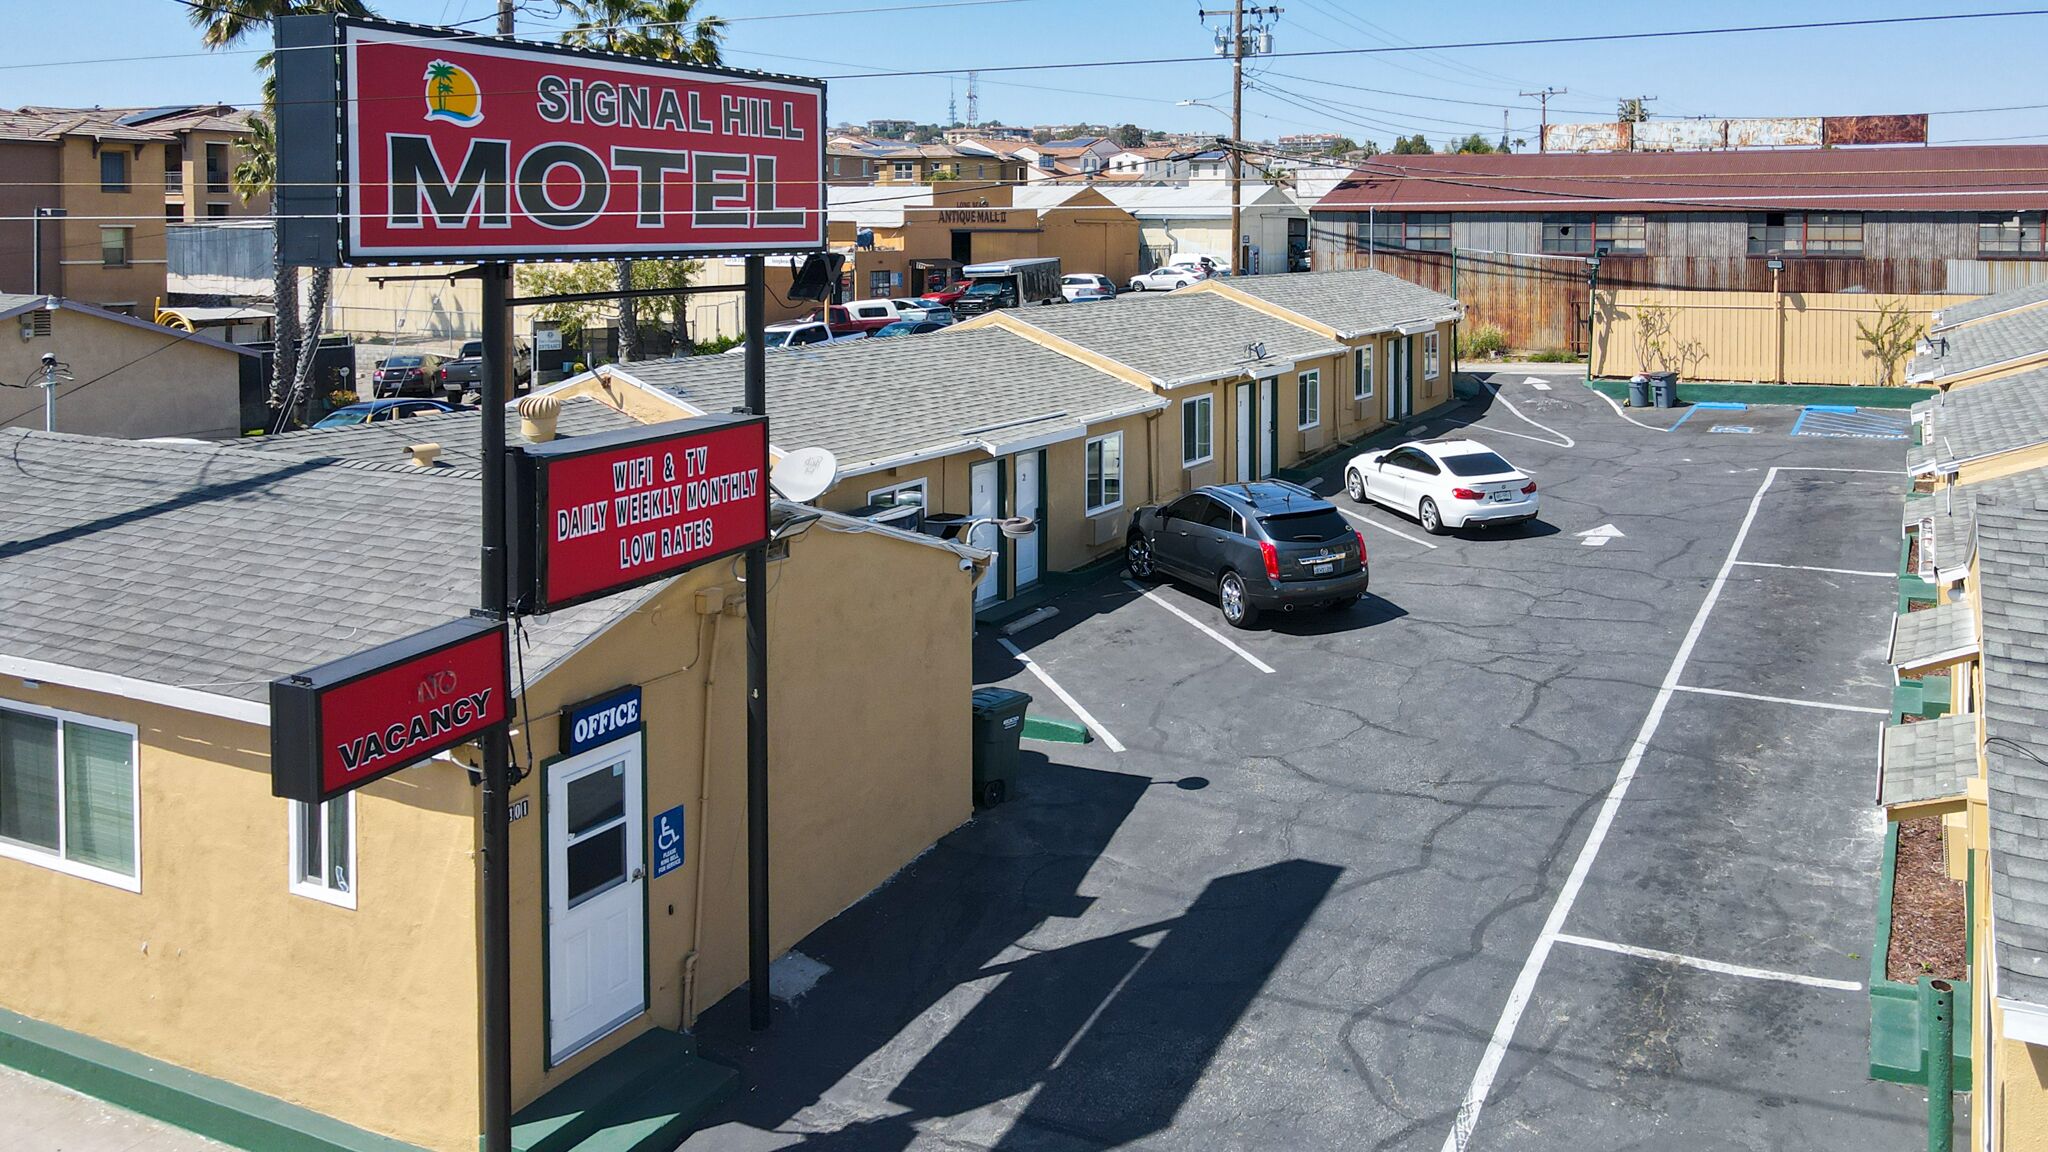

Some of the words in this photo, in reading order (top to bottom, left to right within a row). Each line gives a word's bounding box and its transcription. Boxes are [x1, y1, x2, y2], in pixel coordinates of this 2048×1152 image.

[537, 75, 713, 134] SIGNAL
[721, 95, 804, 141] HILL
[385, 132, 807, 230] MOTEL
[938, 210, 976, 224] ANTIQUE
[977, 210, 1000, 223] MALL
[612, 456, 654, 492] WIFI
[662, 452, 676, 483] &
[685, 445, 708, 477] TV
[557, 500, 608, 542] DAILY
[614, 484, 682, 528] WEEKLY
[686, 468, 758, 511] MONTHLY
[620, 530, 656, 569] LOW
[660, 517, 713, 559] RATES
[338, 688, 492, 772] VACANCY
[574, 698, 639, 743] OFFICE
